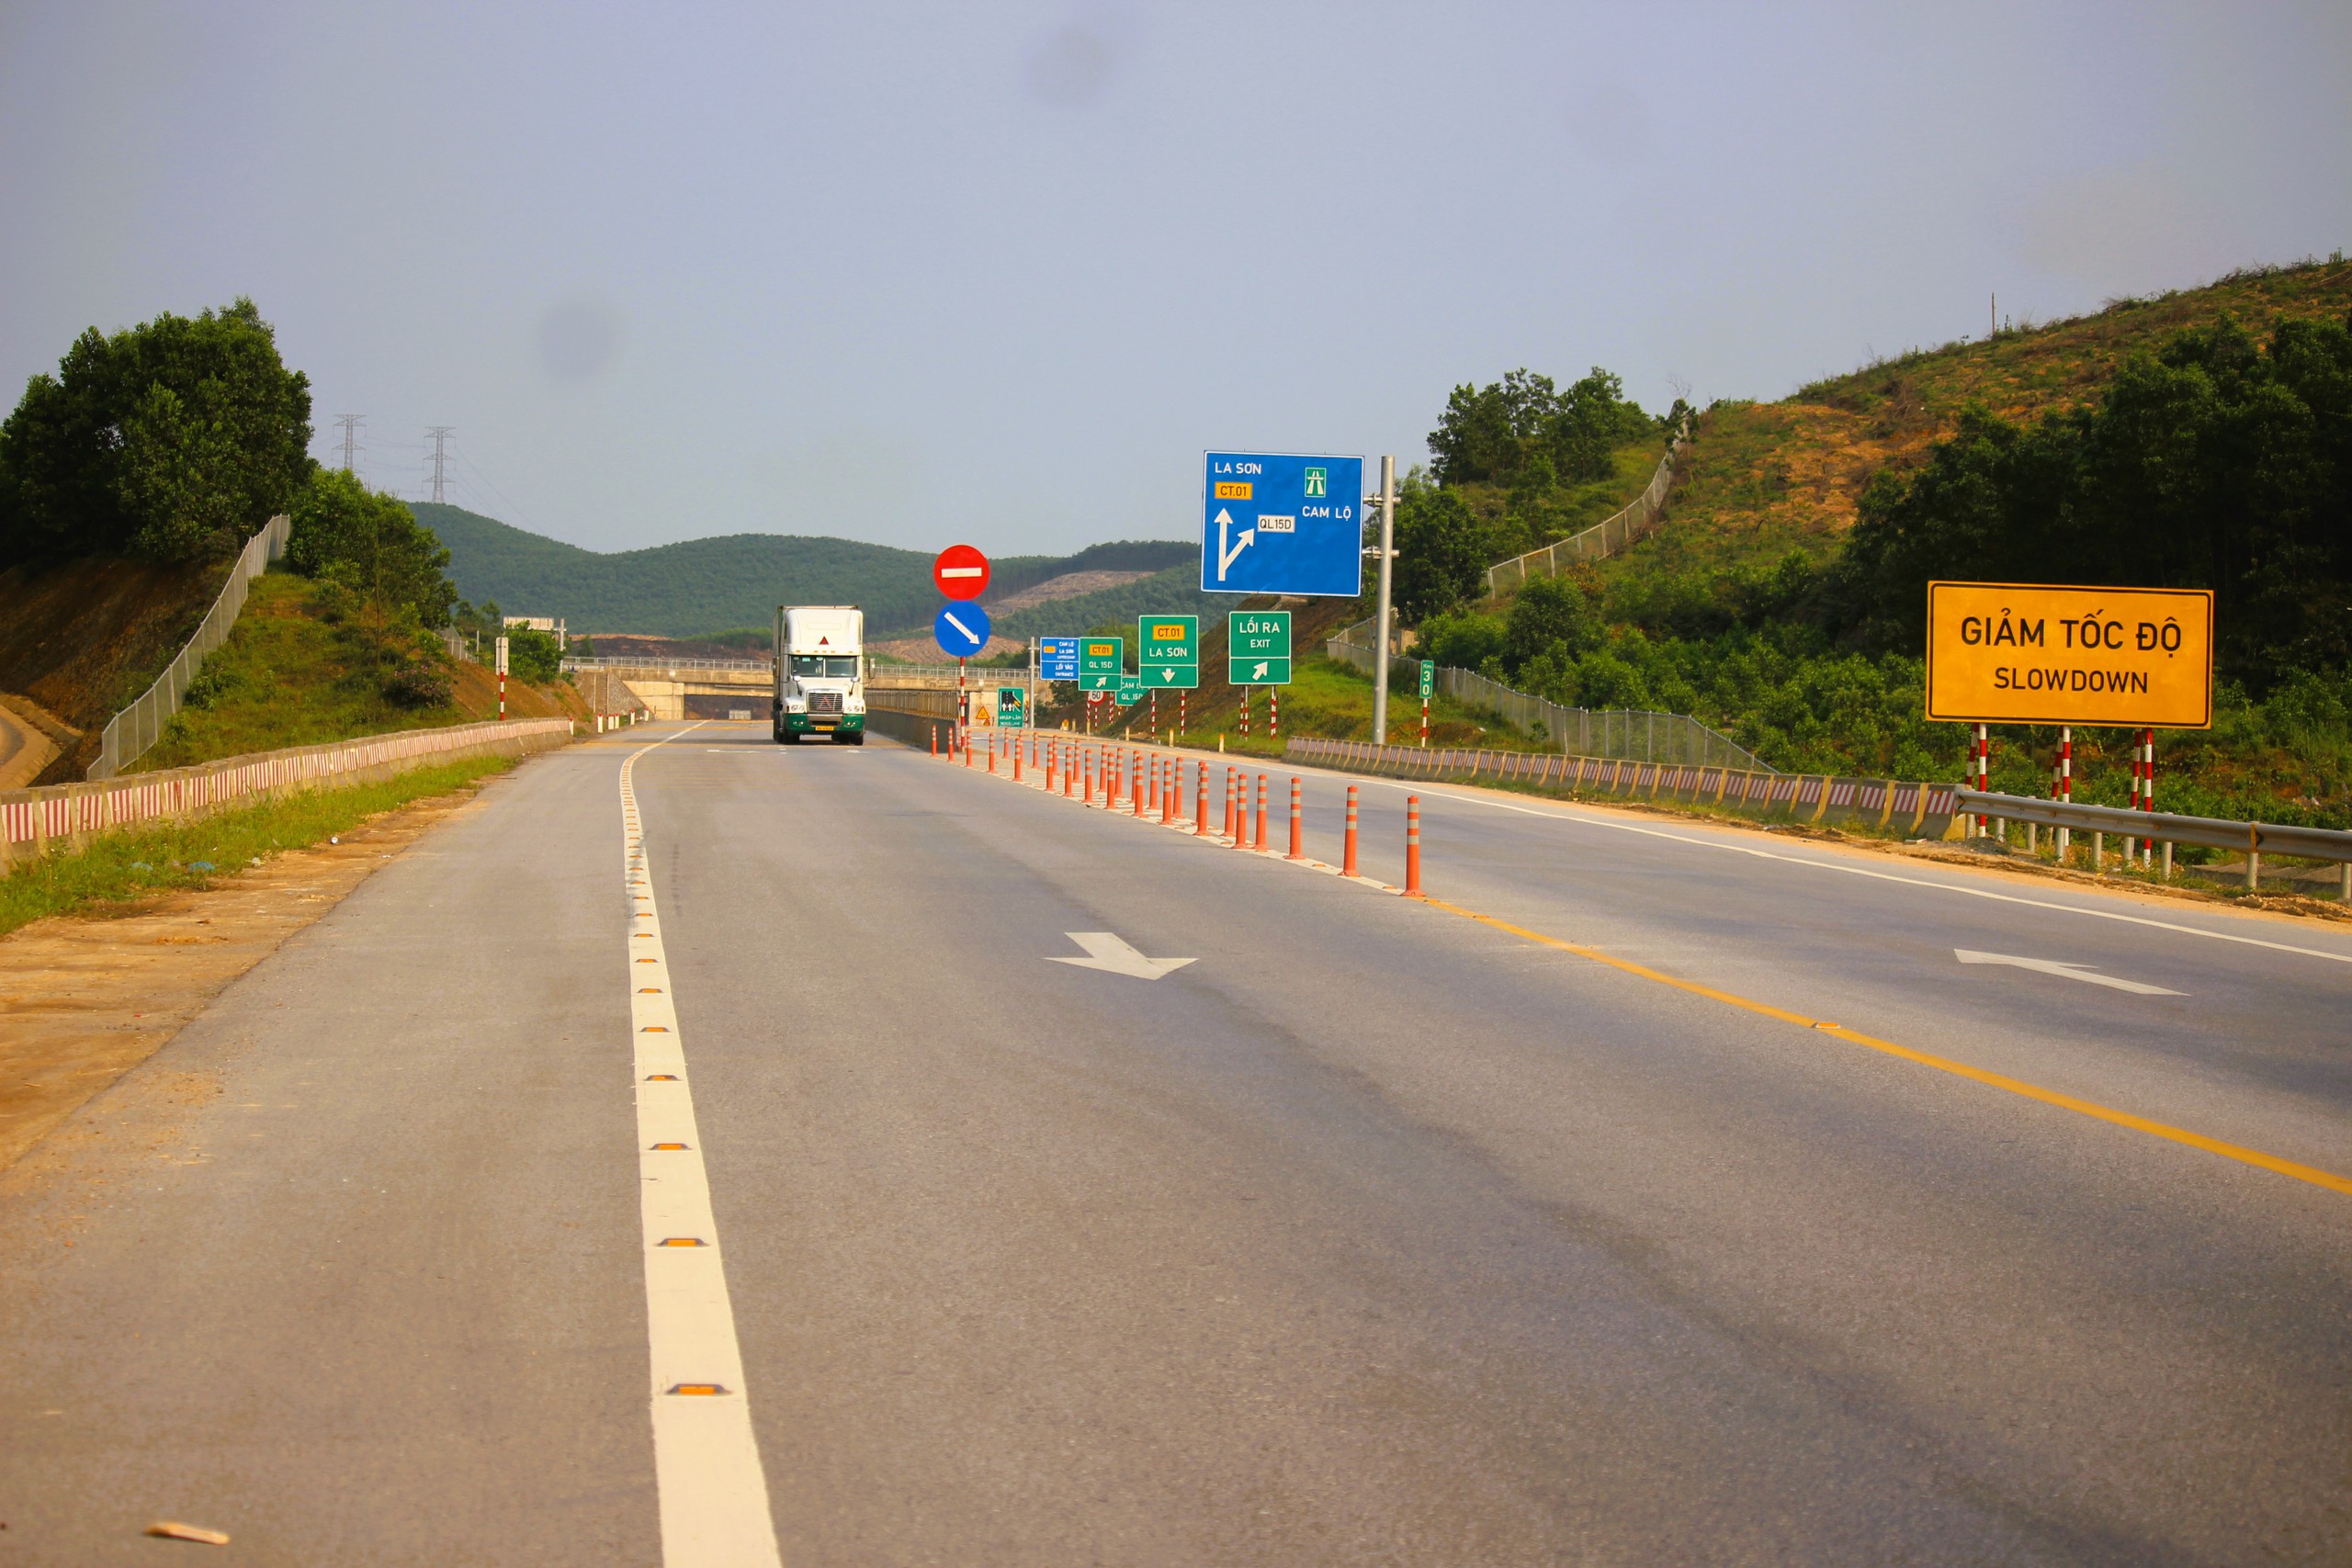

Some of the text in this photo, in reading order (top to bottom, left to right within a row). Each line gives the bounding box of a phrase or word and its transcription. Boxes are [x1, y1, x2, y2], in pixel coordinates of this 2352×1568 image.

[1215, 462, 1262, 475] LA SƠN
[1220, 485, 1248, 497] CT.01
[1302, 505, 1351, 522] CAM LỘ
[1260, 518, 1292, 530] QL15D
[1239, 616, 1281, 634] LỐI RA
[1158, 628, 1181, 637] CT.01
[1961, 607, 2182, 659] GIẢM TỐC ĐỘ
[1250, 638, 1272, 649] EXIT
[1149, 646, 1188, 658] LA SƠN
[1994, 667, 2148, 694] SLOWDOWN
[1092, 691, 1101, 699] 60
